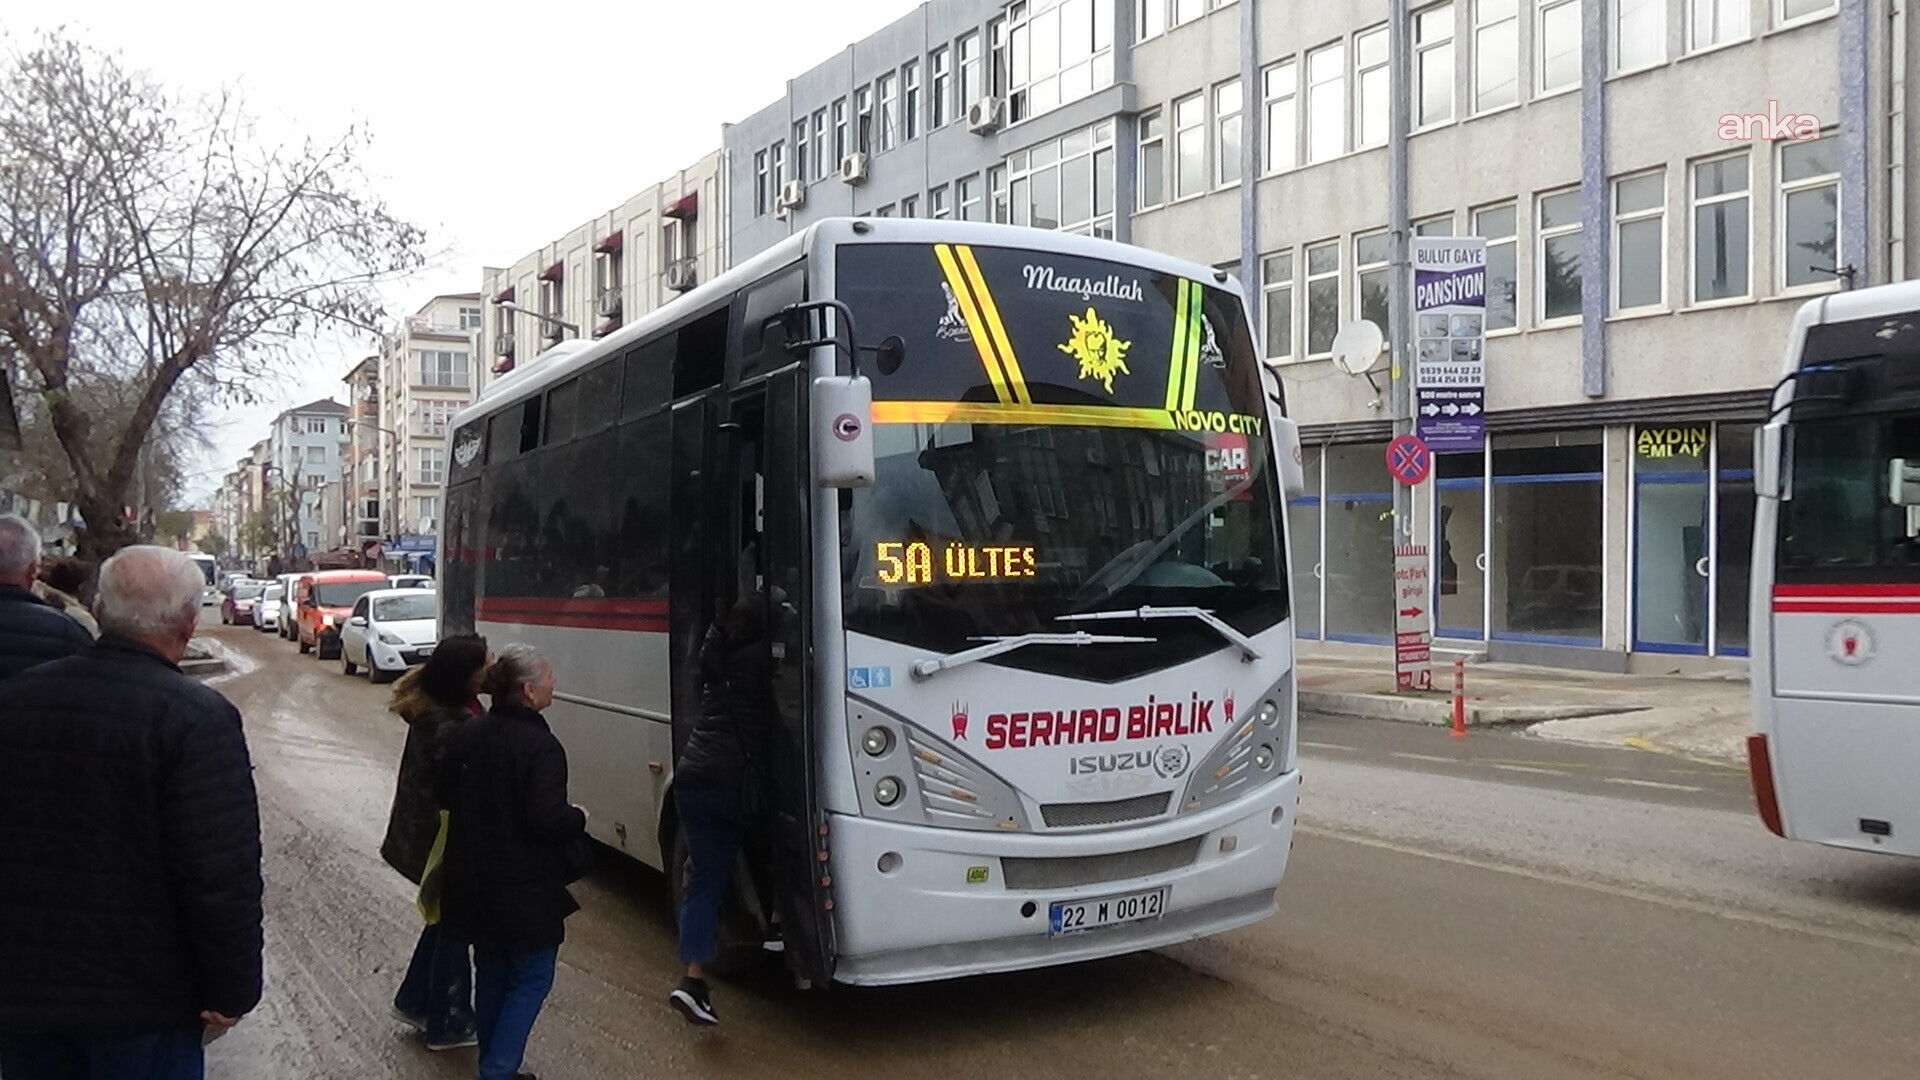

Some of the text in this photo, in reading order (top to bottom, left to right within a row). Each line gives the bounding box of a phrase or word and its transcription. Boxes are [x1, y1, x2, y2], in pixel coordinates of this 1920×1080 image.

[1418, 249, 1482, 264] BULUT GAYE
[1023, 264, 1143, 301] Maaşallah
[1417, 272, 1484, 308] PANSİYON
[1175, 410, 1262, 436] NOVO CITY
[1637, 428, 1707, 445] AYDIN
[1205, 448, 1247, 471] CAR
[877, 542, 1035, 583] 5A ÜLTES
[985, 691, 1214, 750] SERHAD BİRLİK
[1070, 750, 1152, 775] ISUZU
[1063, 894, 1158, 928] 22 M 0012
